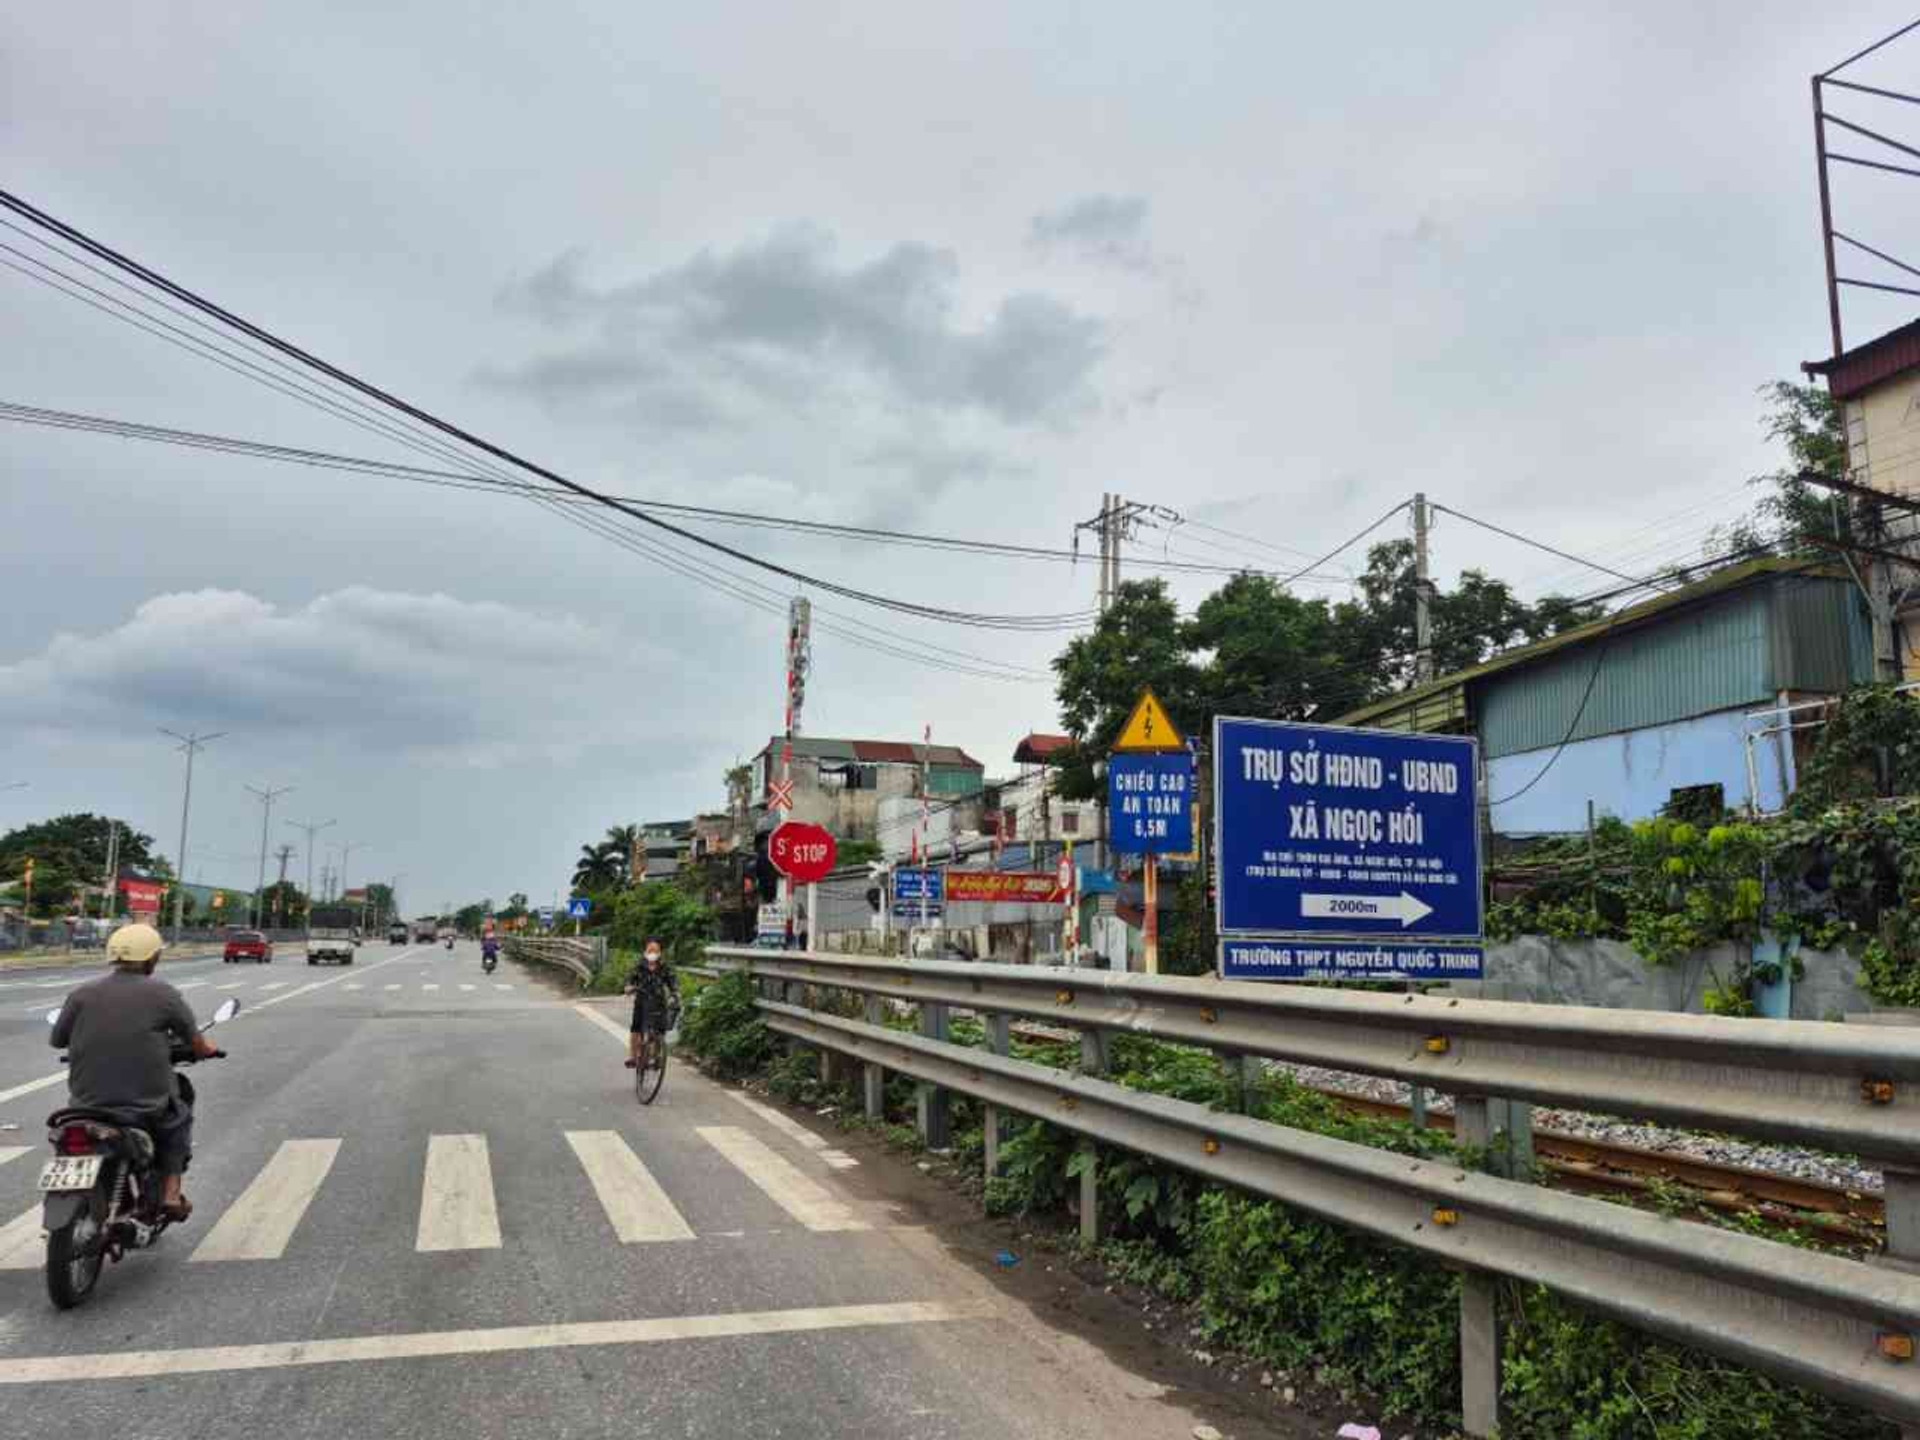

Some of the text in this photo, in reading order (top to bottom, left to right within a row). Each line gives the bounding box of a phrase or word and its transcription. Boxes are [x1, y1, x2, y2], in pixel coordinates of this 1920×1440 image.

[1241, 746, 1284, 790] TRỤ
[1290, 738, 1321, 785] SỞ
[1325, 753, 1382, 790] HĐND
[1402, 759, 1459, 794] UBND
[1159, 773, 1185, 792] CAO
[1122, 793, 1181, 815] AN TOÀN
[1288, 799, 1320, 840] XÃ
[1324, 806, 1383, 850] NGỌC
[793, 844, 828, 864] STOP
[1329, 900, 1378, 914] 2000m
[1230, 945, 1292, 966] TRƯỜNG
[1295, 949, 1332, 966] THPT
[1397, 948, 1435, 970] QUỐC
